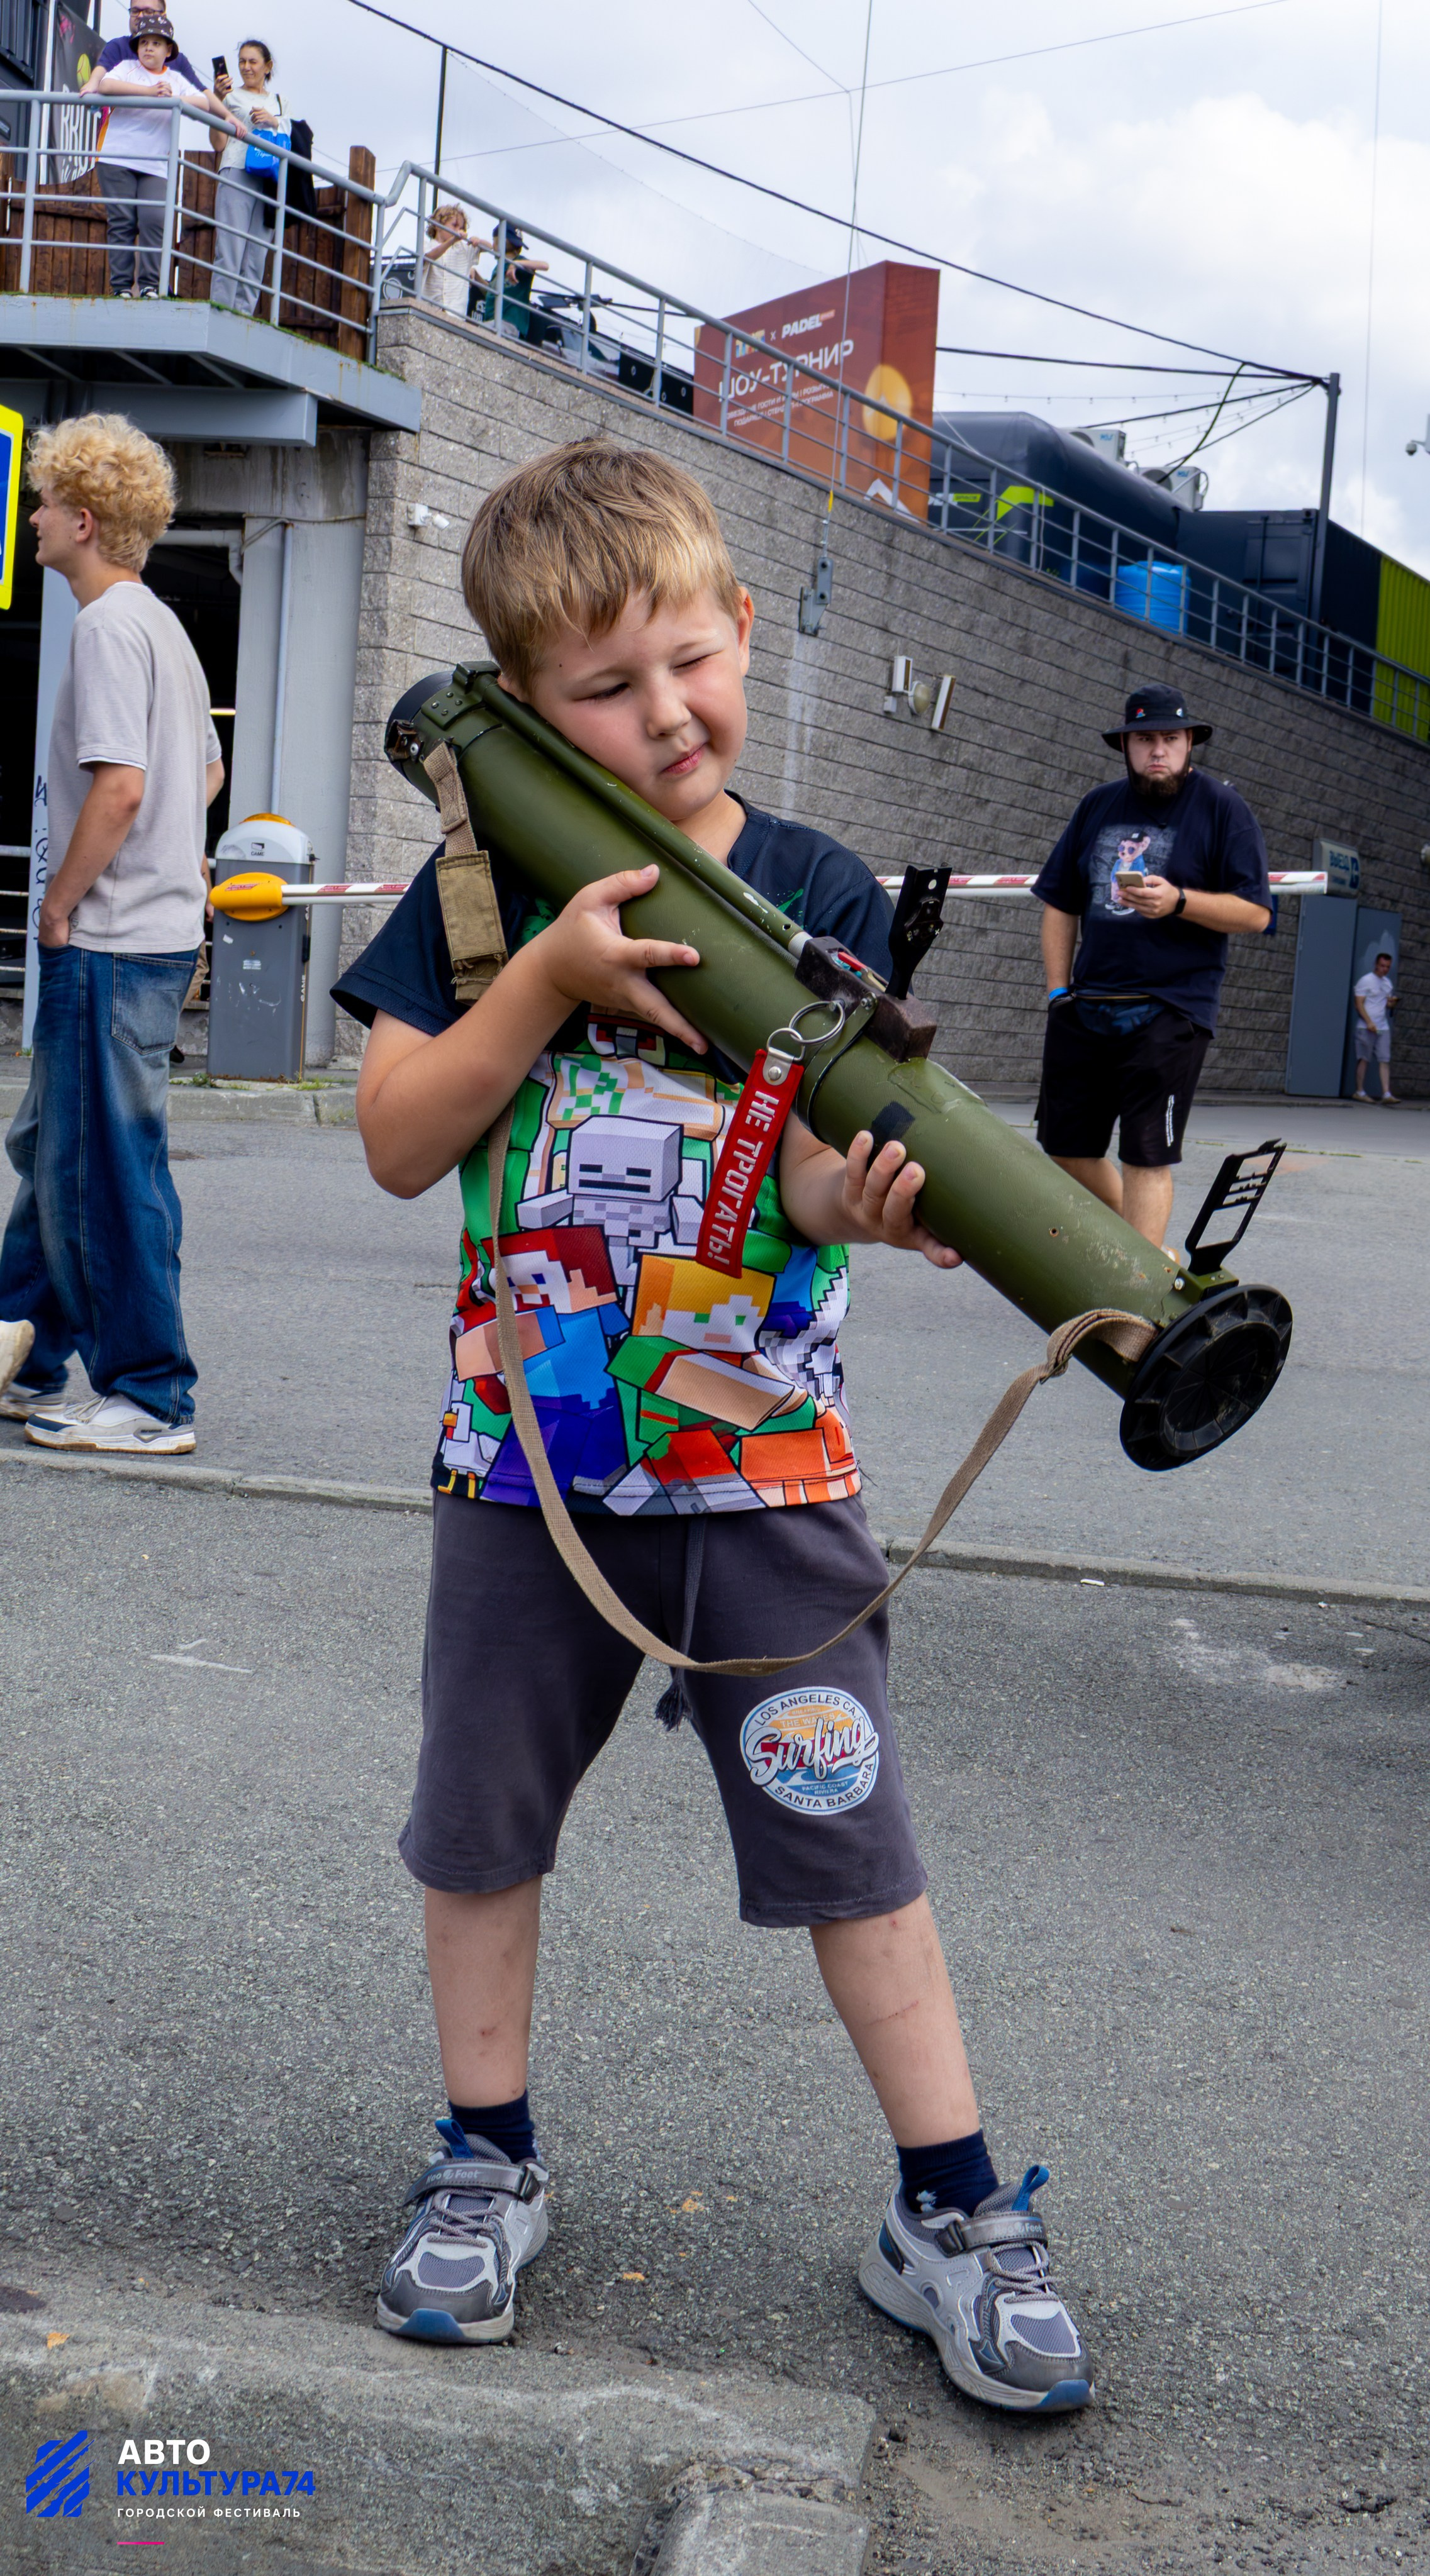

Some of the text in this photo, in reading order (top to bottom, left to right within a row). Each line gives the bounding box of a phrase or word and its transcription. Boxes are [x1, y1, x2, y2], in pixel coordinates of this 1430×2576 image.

[781, 313, 823, 339] PADEL
[708, 1091, 779, 1265] НЕ ТРОГАТЬ!
[755, 1694, 856, 1726] LOS ANGELES CA.
[780, 1718, 800, 1728] THE
[745, 1716, 879, 1787] Surfing
[775, 1763, 874, 1807] SANTA BARBARA
[827, 1781, 848, 1789] COAST
